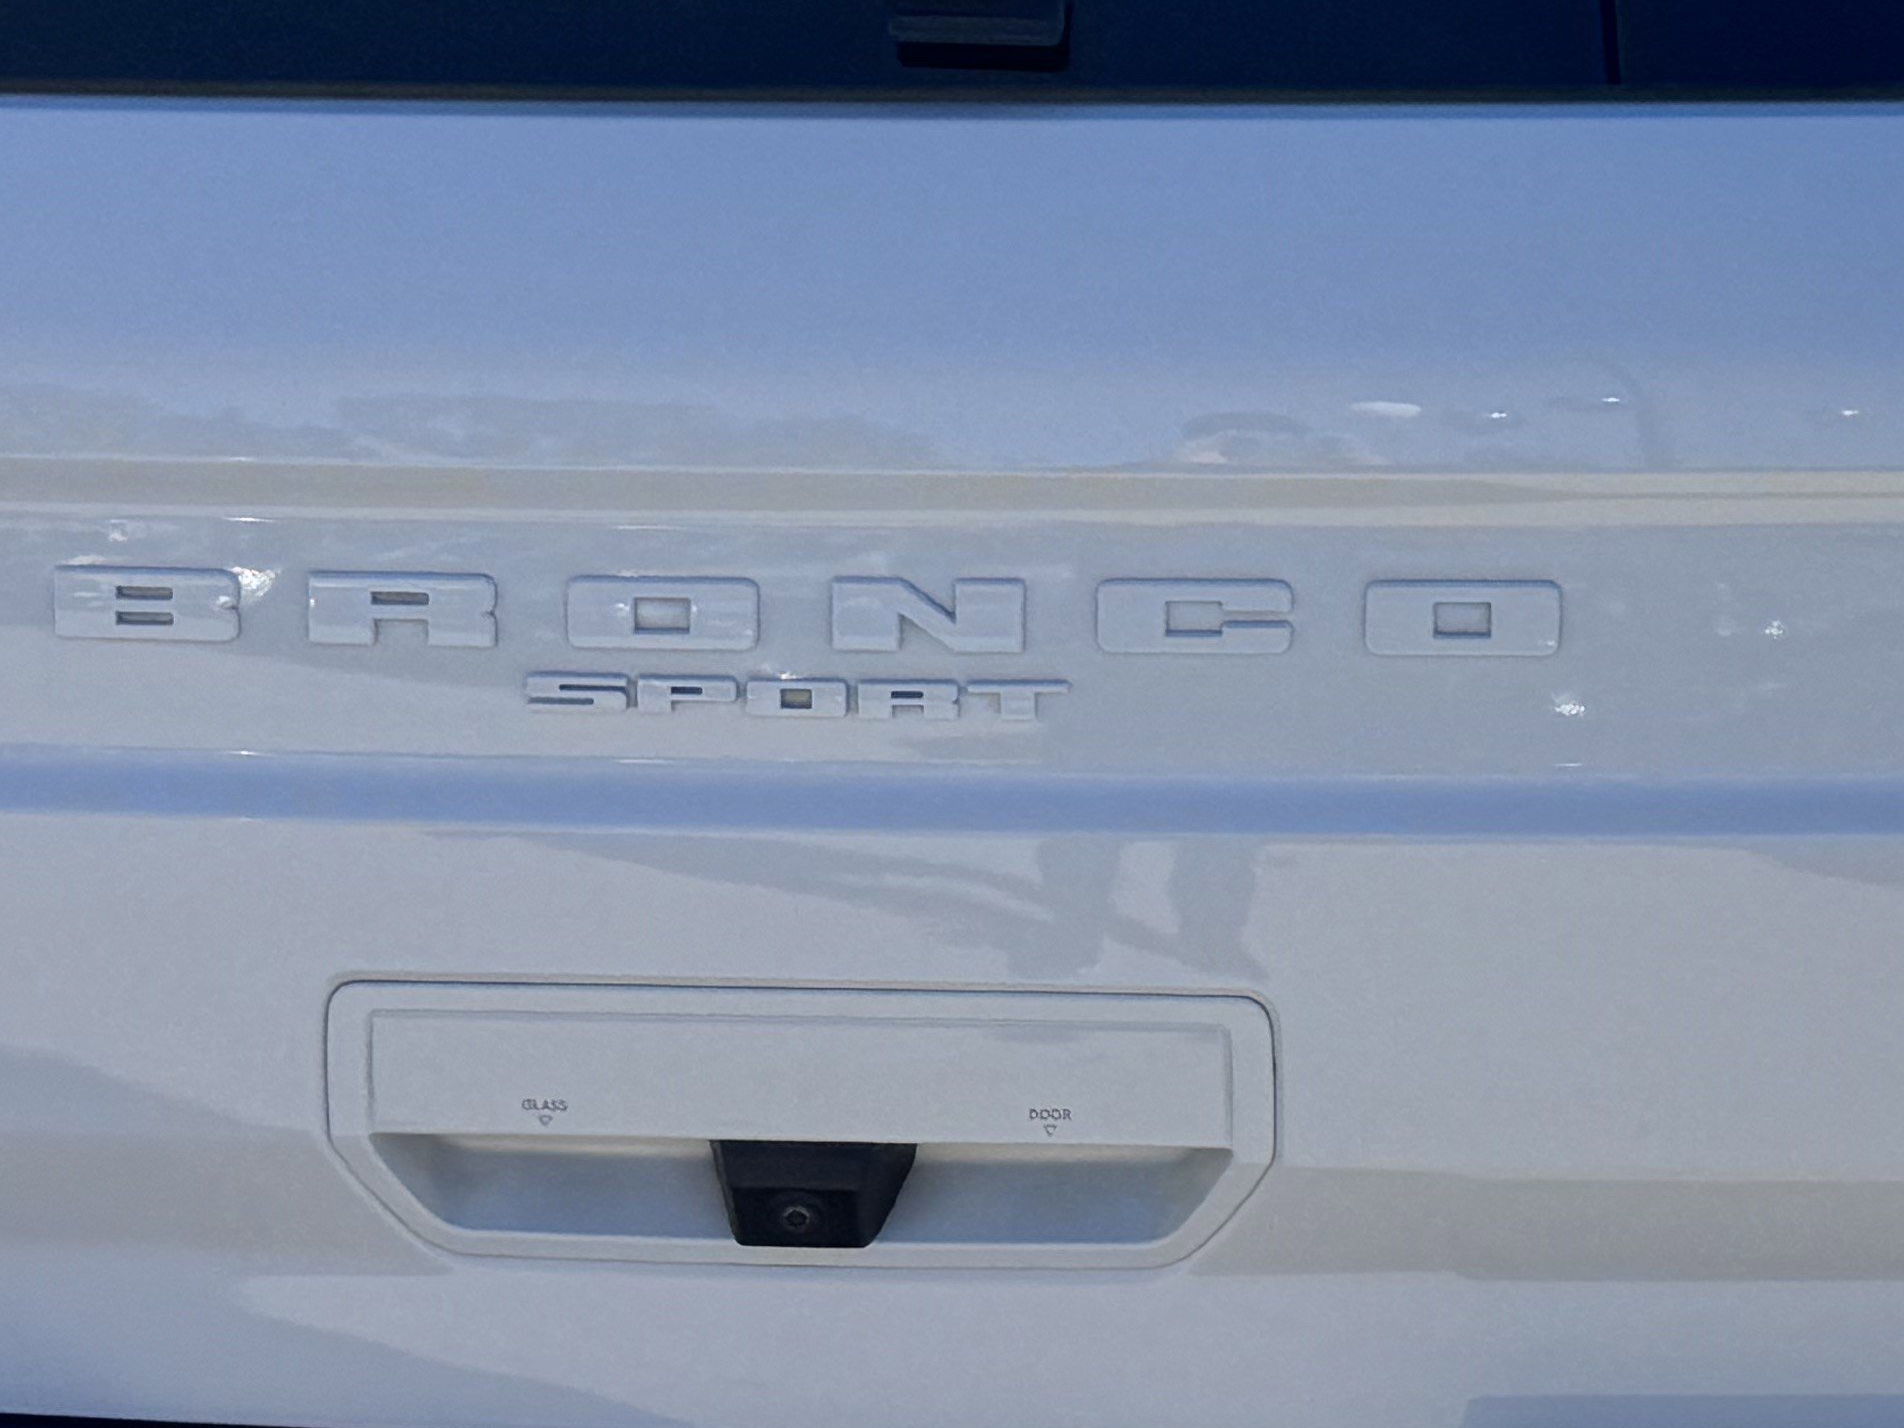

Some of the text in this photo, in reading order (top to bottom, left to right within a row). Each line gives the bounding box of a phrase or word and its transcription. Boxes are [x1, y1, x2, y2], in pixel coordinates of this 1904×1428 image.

[54, 566, 1562, 657] BRONCO
[526, 673, 1072, 720] SPORT
[1029, 1108, 1072, 1121] DOOR
